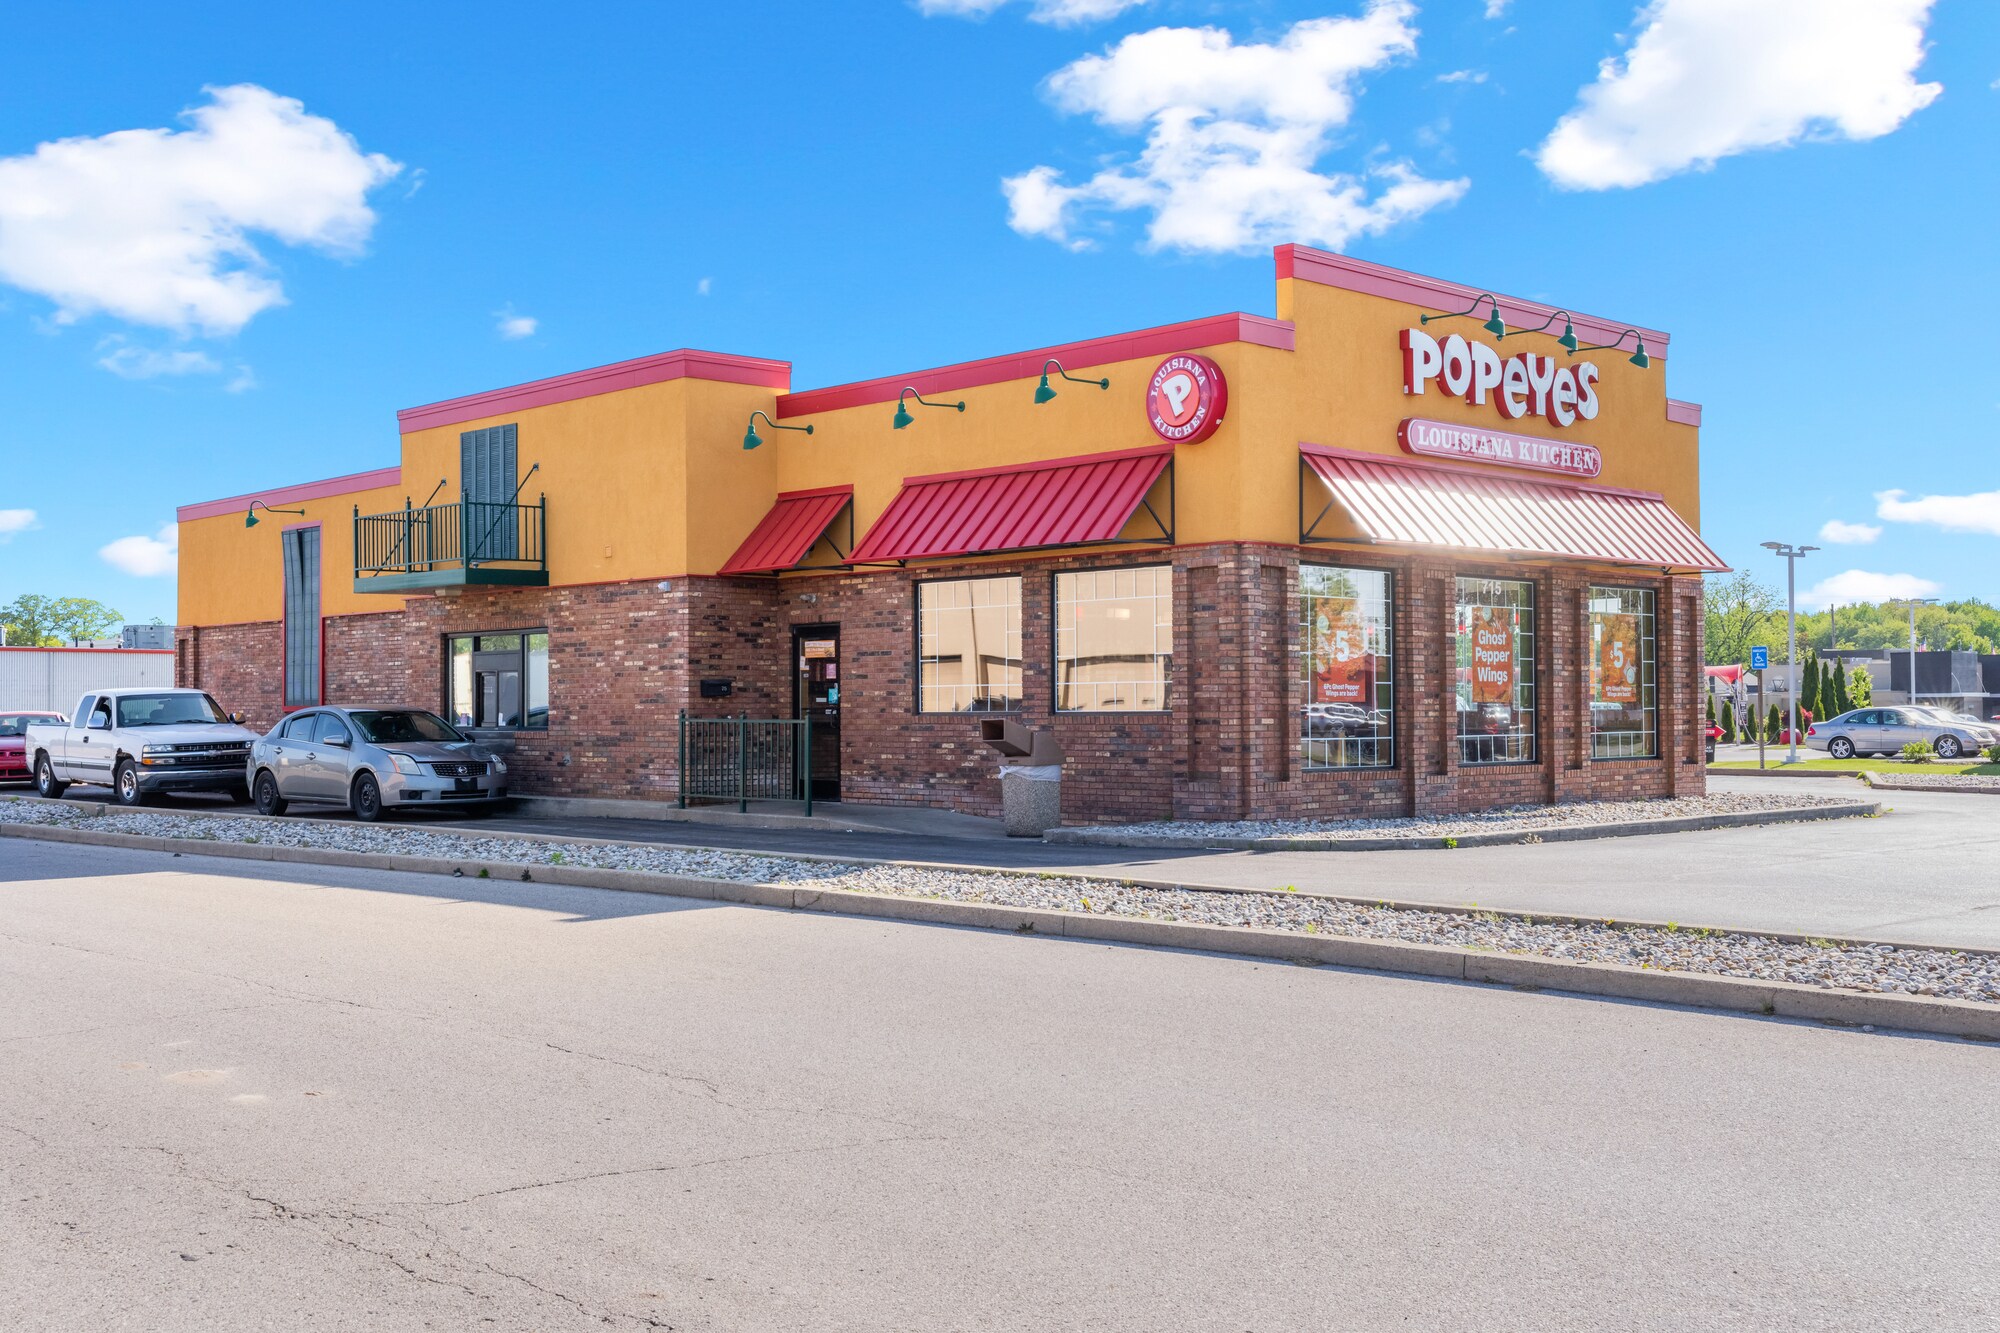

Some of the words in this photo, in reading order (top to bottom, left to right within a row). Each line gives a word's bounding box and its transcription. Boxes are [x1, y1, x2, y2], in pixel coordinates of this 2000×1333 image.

[1151, 358, 1206, 397] LOUISIANA
[1161, 374, 1192, 417] P
[1154, 405, 1206, 437] KITCHEN
[1417, 425, 1513, 458] LOUISIANA
[1518, 441, 1596, 471] KITCHEN
[1482, 580, 1501, 595] 715
[1478, 629, 1507, 645] Ghost
[1475, 647, 1510, 665] Pepper
[1609, 641, 1623, 668] $5
[1477, 666, 1508, 685] Wings
